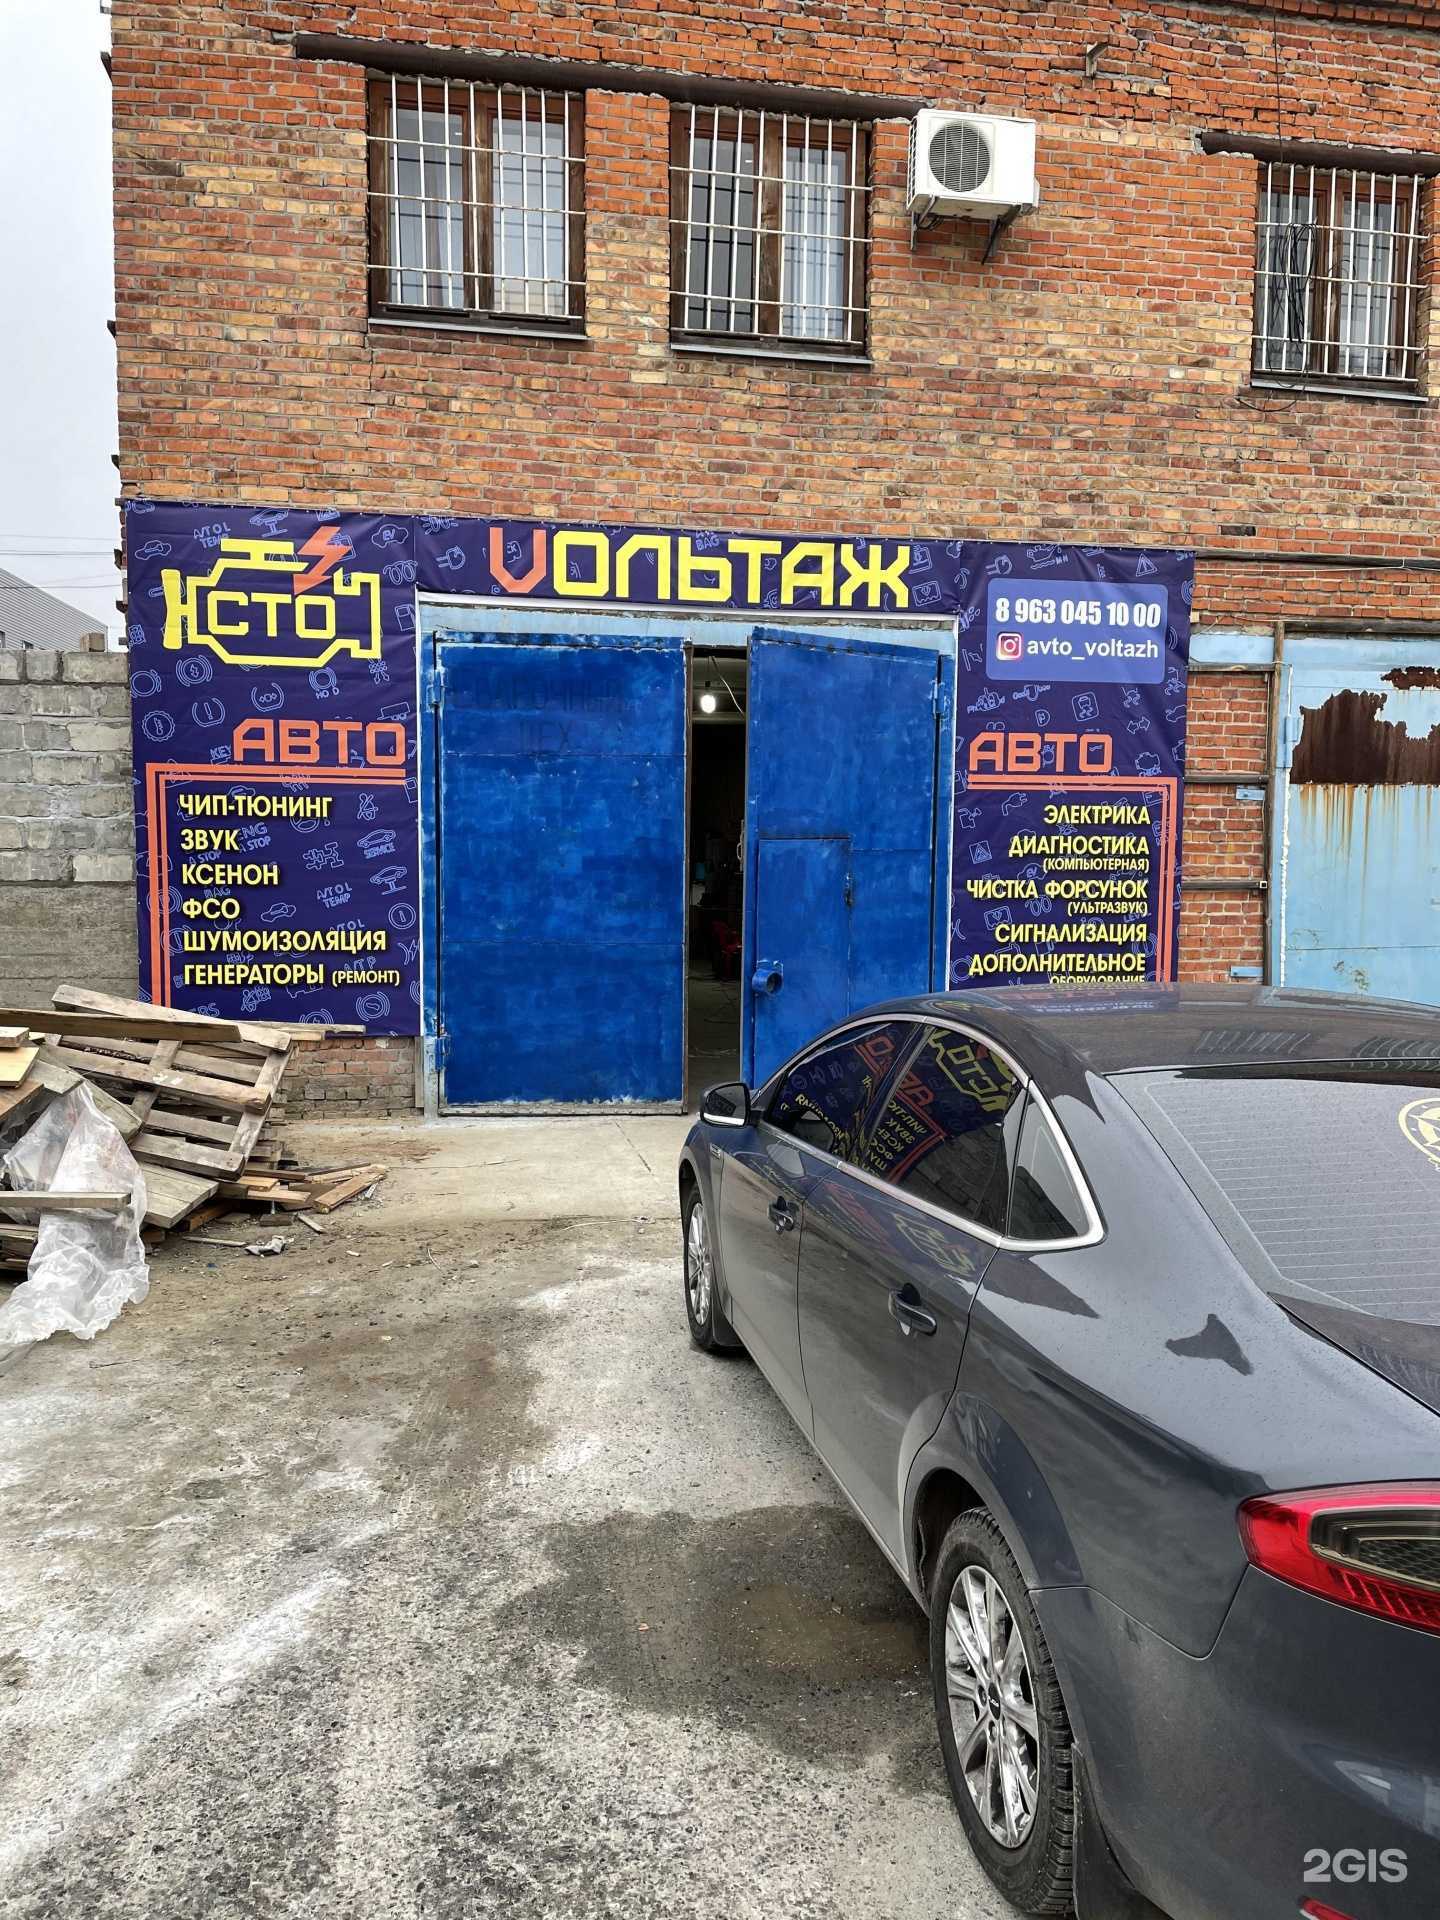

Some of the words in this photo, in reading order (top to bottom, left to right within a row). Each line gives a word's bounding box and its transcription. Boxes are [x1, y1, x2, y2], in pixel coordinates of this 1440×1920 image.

[207, 590, 336, 639] СТО
[995, 598, 1010, 623] 8
[1015, 598, 1056, 624] 963
[1060, 599, 1102, 626] 045
[1106, 602, 1130, 627] 10
[1133, 603, 1162, 628] 00
[1027, 636, 1159, 661] avto_voltazh
[233, 718, 406, 765] АВТО
[969, 731, 1113, 773] АВТО
[178, 794, 333, 818] ЧИП-ТЮНИНГ
[1043, 804, 1151, 825] ЭЛЕКТРИКА
[180, 829, 240, 851] ЗВУК
[1008, 835, 1150, 858] ДИАГНОСТИКА
[181, 864, 279, 886] КСЕНОН
[1043, 858, 1150, 873] (КОМПЬЮТЕРНАЯ)
[966, 879, 1038, 900] ЧИСТКА
[1044, 879, 1148, 900] ФОРСУНОК
[182, 898, 240, 920] ФСО
[1067, 901, 1148, 917] (УЛЬТРАЗВУК)
[183, 930, 386, 955] ШУМОИЗОЛЯЦИЯ
[994, 923, 1147, 945] СИГНАЛИЗАЦИЯ
[184, 963, 324, 986] ГЕНЕРАТОРЫ
[332, 969, 400, 988] (РЕМОНТ)
[968, 953, 1146, 976] ДОПОЛНИТЕЛЬНОЕ
